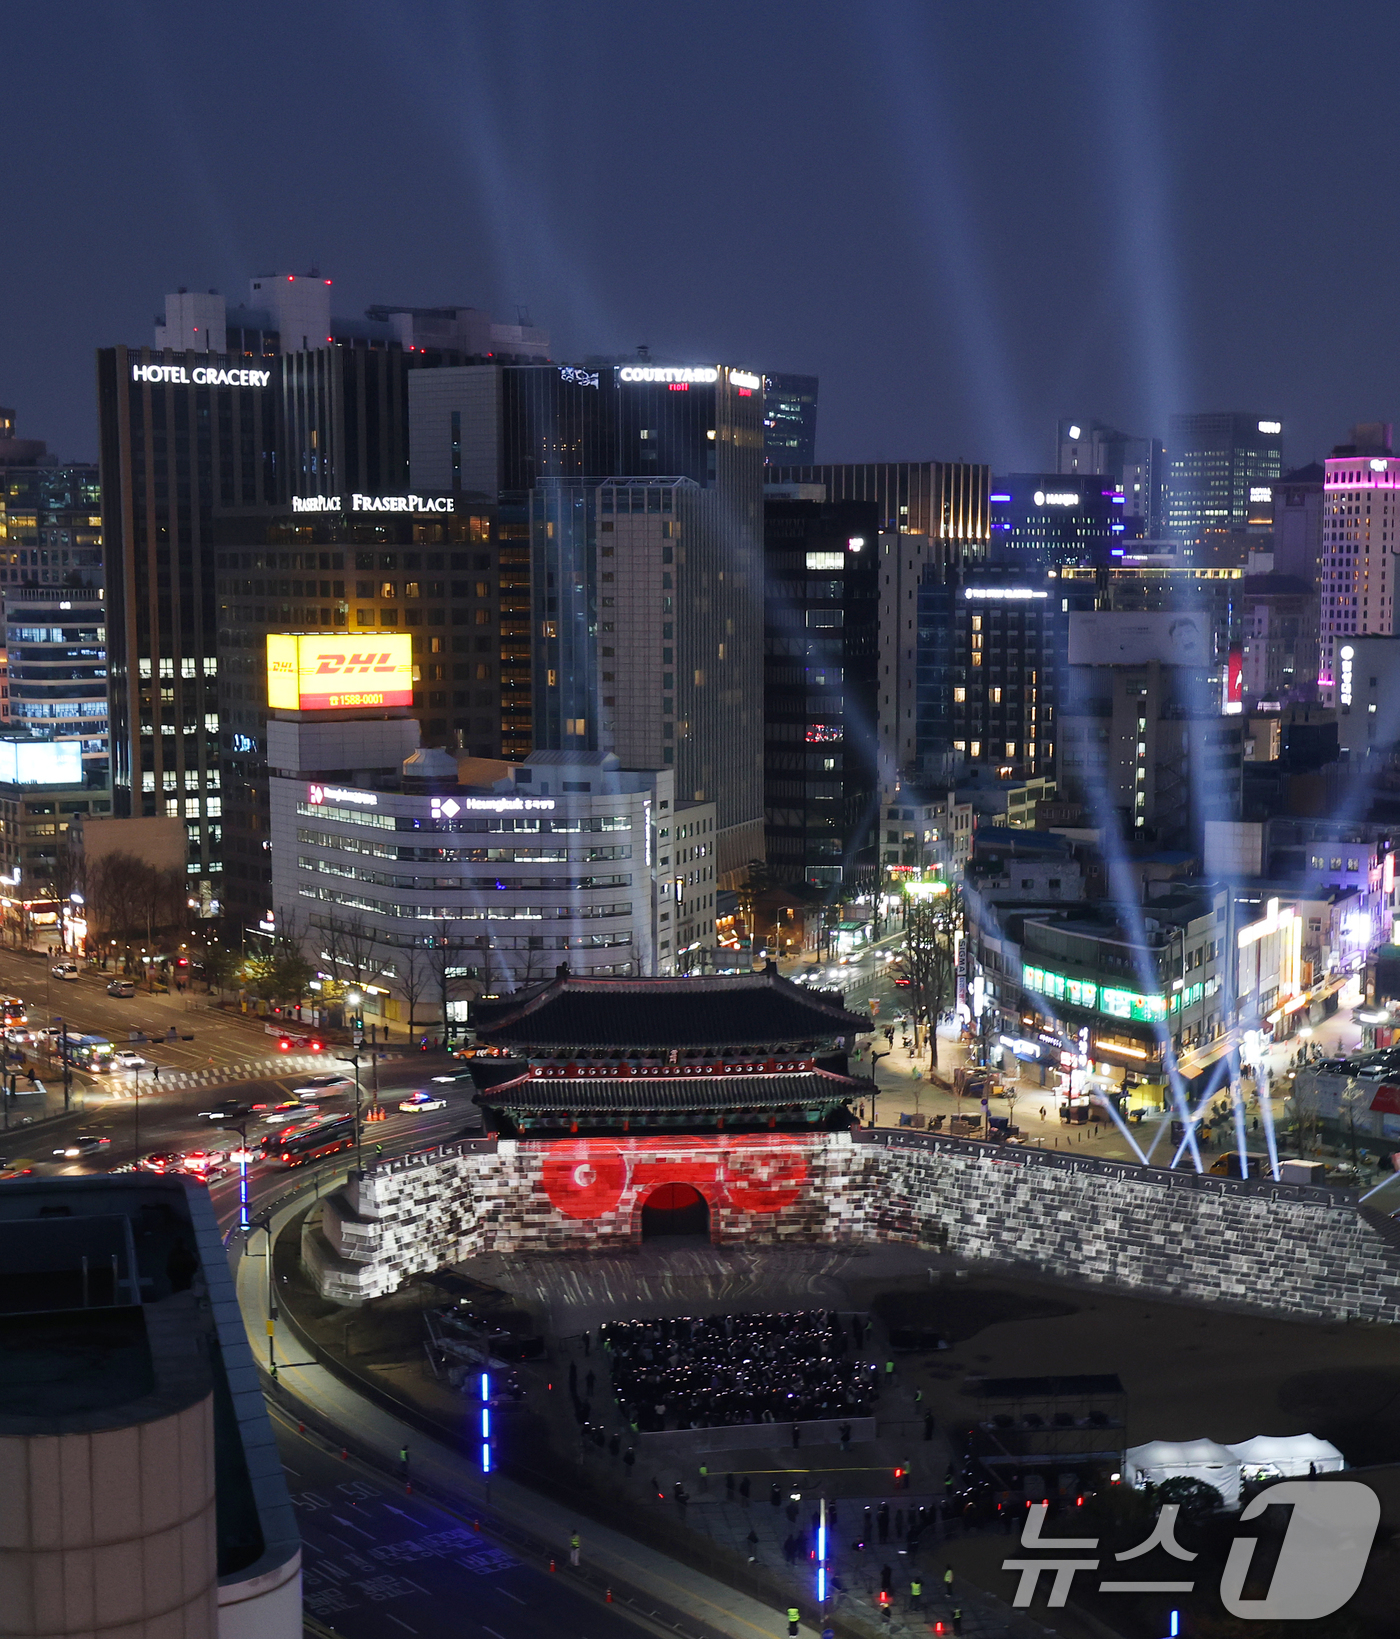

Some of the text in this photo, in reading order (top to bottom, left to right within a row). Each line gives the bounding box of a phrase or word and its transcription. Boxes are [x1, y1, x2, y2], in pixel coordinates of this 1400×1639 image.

[132, 364, 270, 387] HOTEL GRACERY
[620, 367, 717, 382] COURTYARD
[272, 661, 293, 672] DHL
[315, 653, 396, 675] DHL
[339, 693, 384, 706] 1588-0001
[958, 940, 966, 973] SIGMA
[336, 1481, 383, 1500] 50
[288, 1491, 331, 1511] 50
